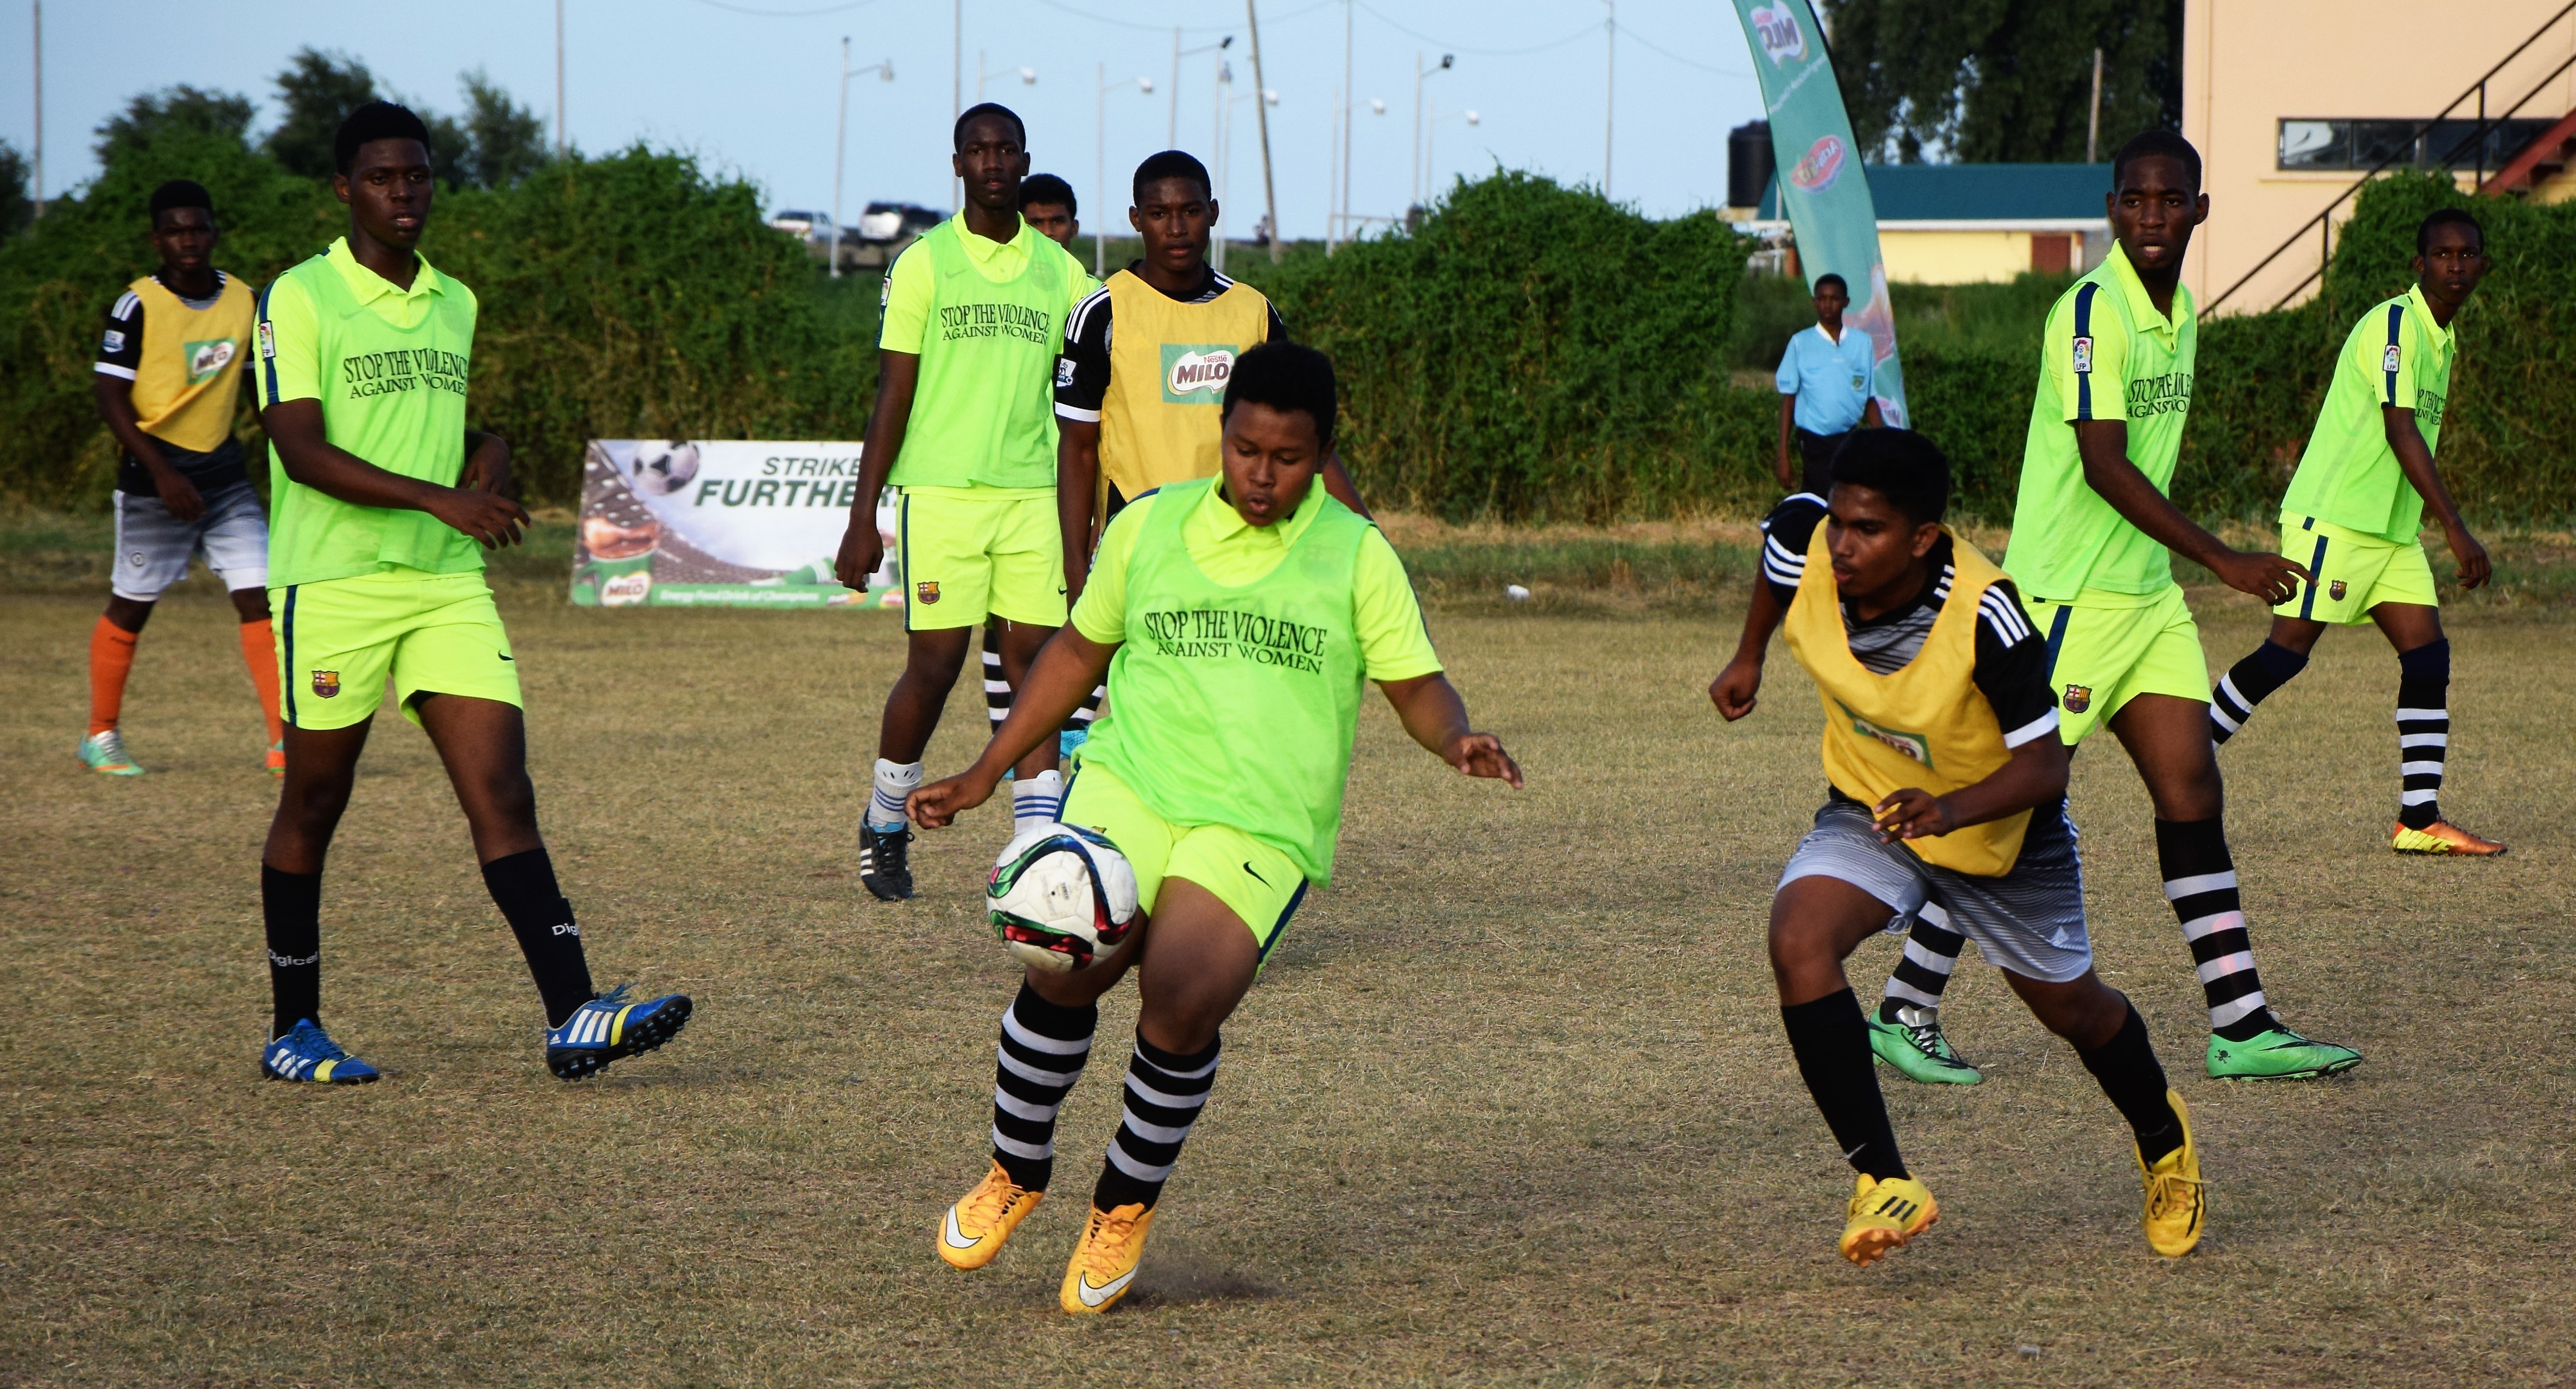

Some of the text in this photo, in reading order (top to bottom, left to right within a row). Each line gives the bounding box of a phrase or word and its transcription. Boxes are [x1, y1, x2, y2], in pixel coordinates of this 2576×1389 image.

[940, 305, 970, 328] STOP
[972, 304, 995, 324] THE
[943, 325, 1047, 345] AGAINST WOMEN
[344, 348, 467, 383] STOP THE VIOLENC
[1176, 363, 1229, 384] MILO
[350, 377, 417, 399] AGAINST
[762, 457, 860, 476] STRIKE
[1144, 610, 1327, 657] STOP THE VIOLENCE
[1237, 643, 1322, 675] WOMEN
